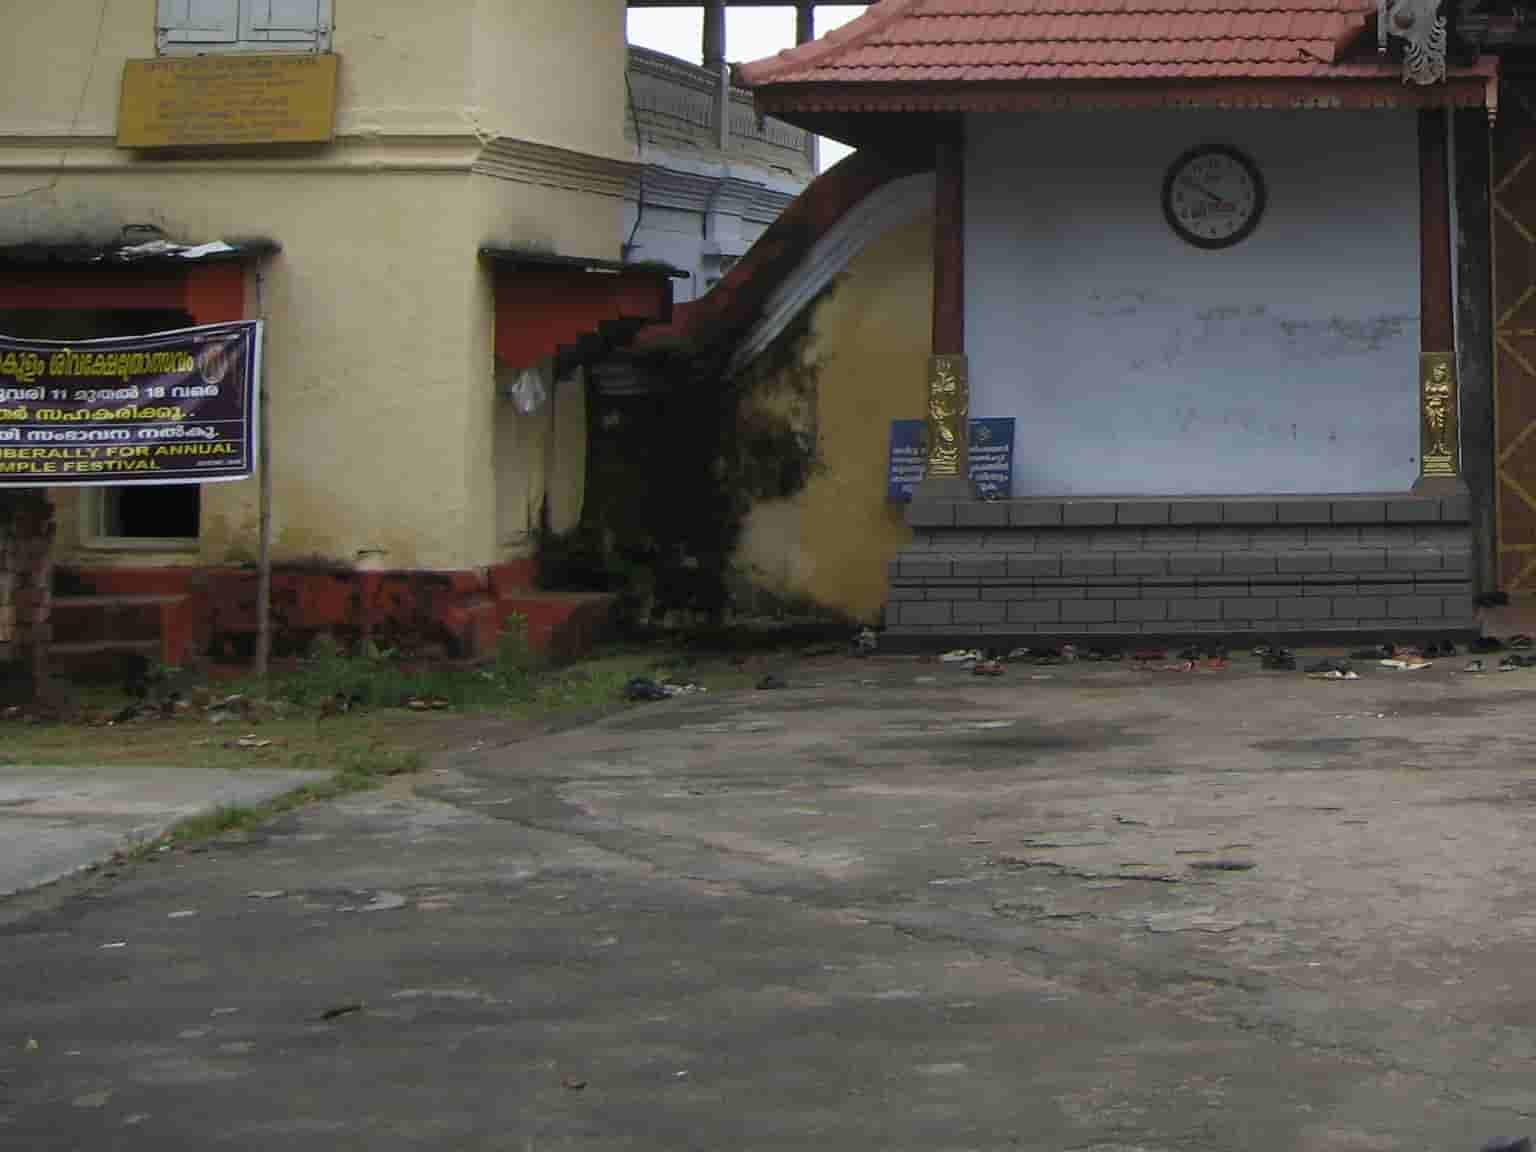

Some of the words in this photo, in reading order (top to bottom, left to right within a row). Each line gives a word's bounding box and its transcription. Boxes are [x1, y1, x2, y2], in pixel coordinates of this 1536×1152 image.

[144, 385, 165, 398] 18
[0, 447, 98, 458] IBERALLY
[106, 446, 150, 458] FOR
[154, 442, 238, 457] ANNUAL
[0, 461, 57, 473] MPLE
[63, 458, 161, 473] FESTIVAL
